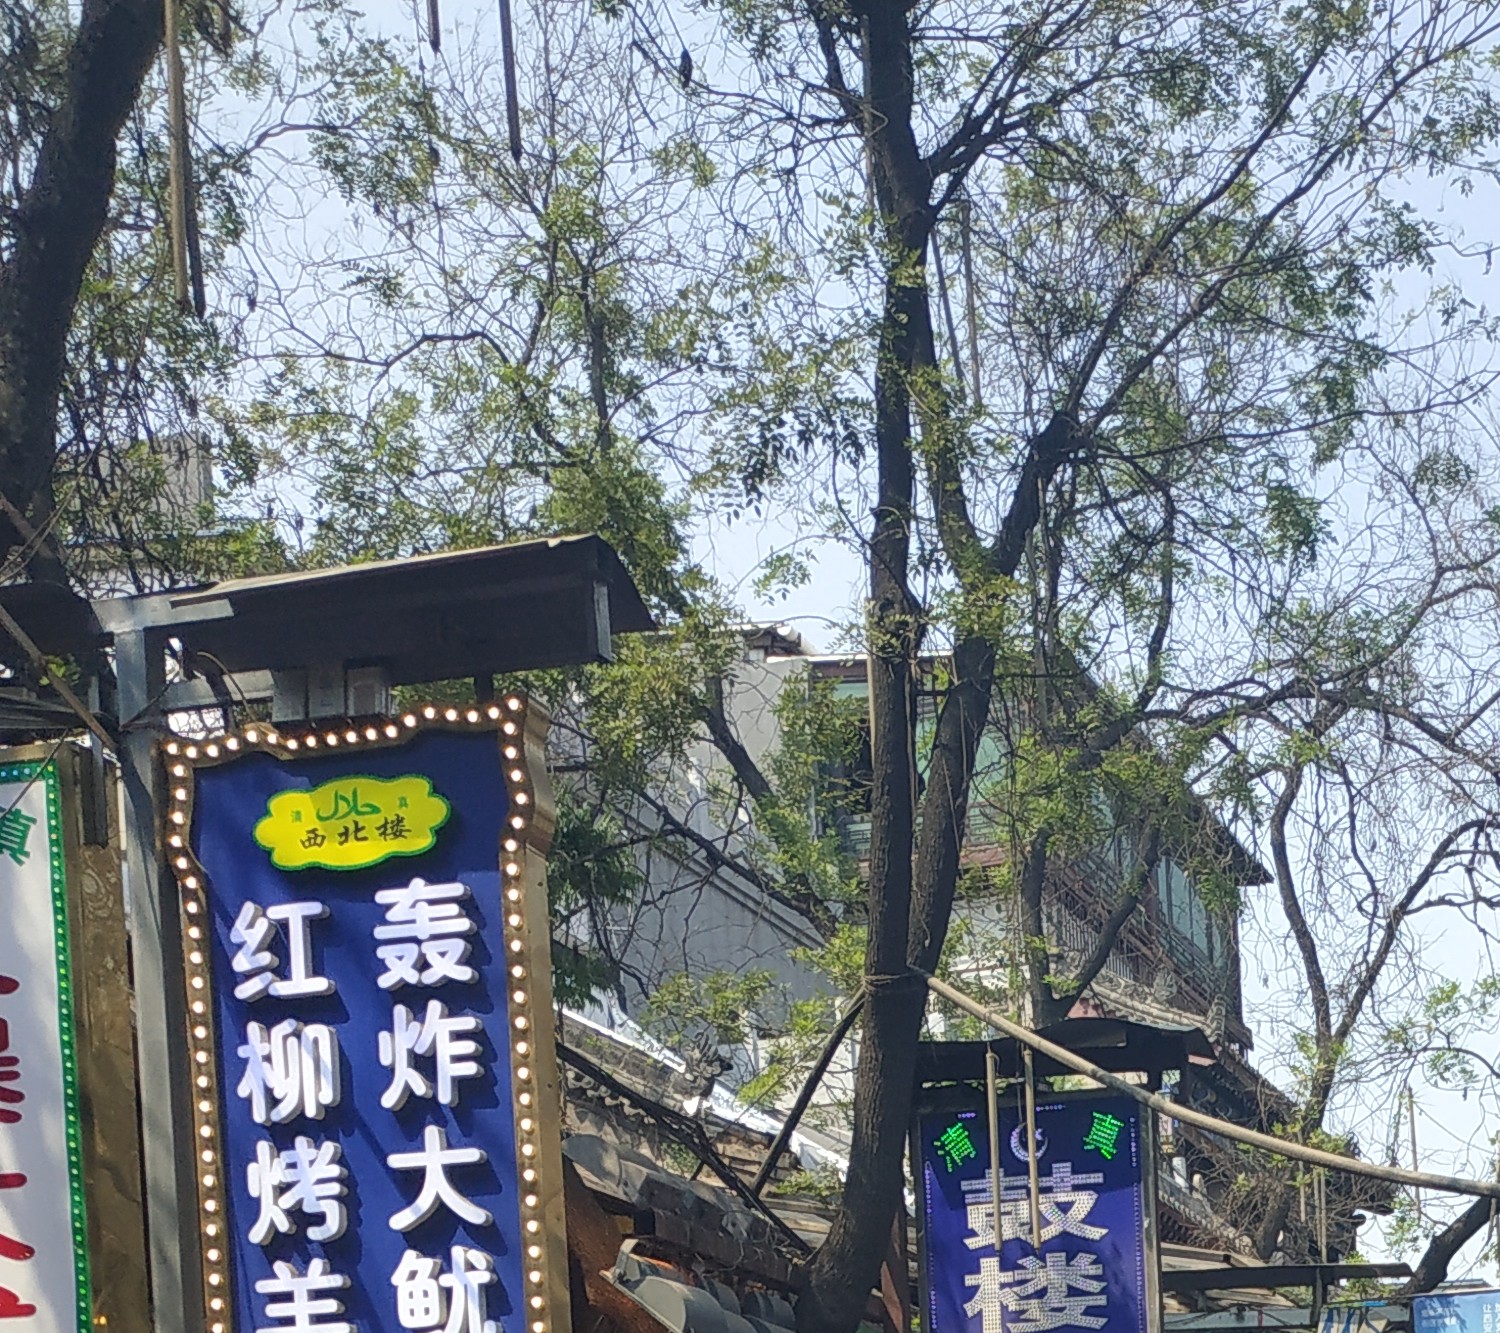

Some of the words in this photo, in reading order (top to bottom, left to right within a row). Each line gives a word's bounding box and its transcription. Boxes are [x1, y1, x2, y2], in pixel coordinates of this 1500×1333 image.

[299, 813, 412, 850] 西北楼
[1083, 1110, 1125, 1161] 真
